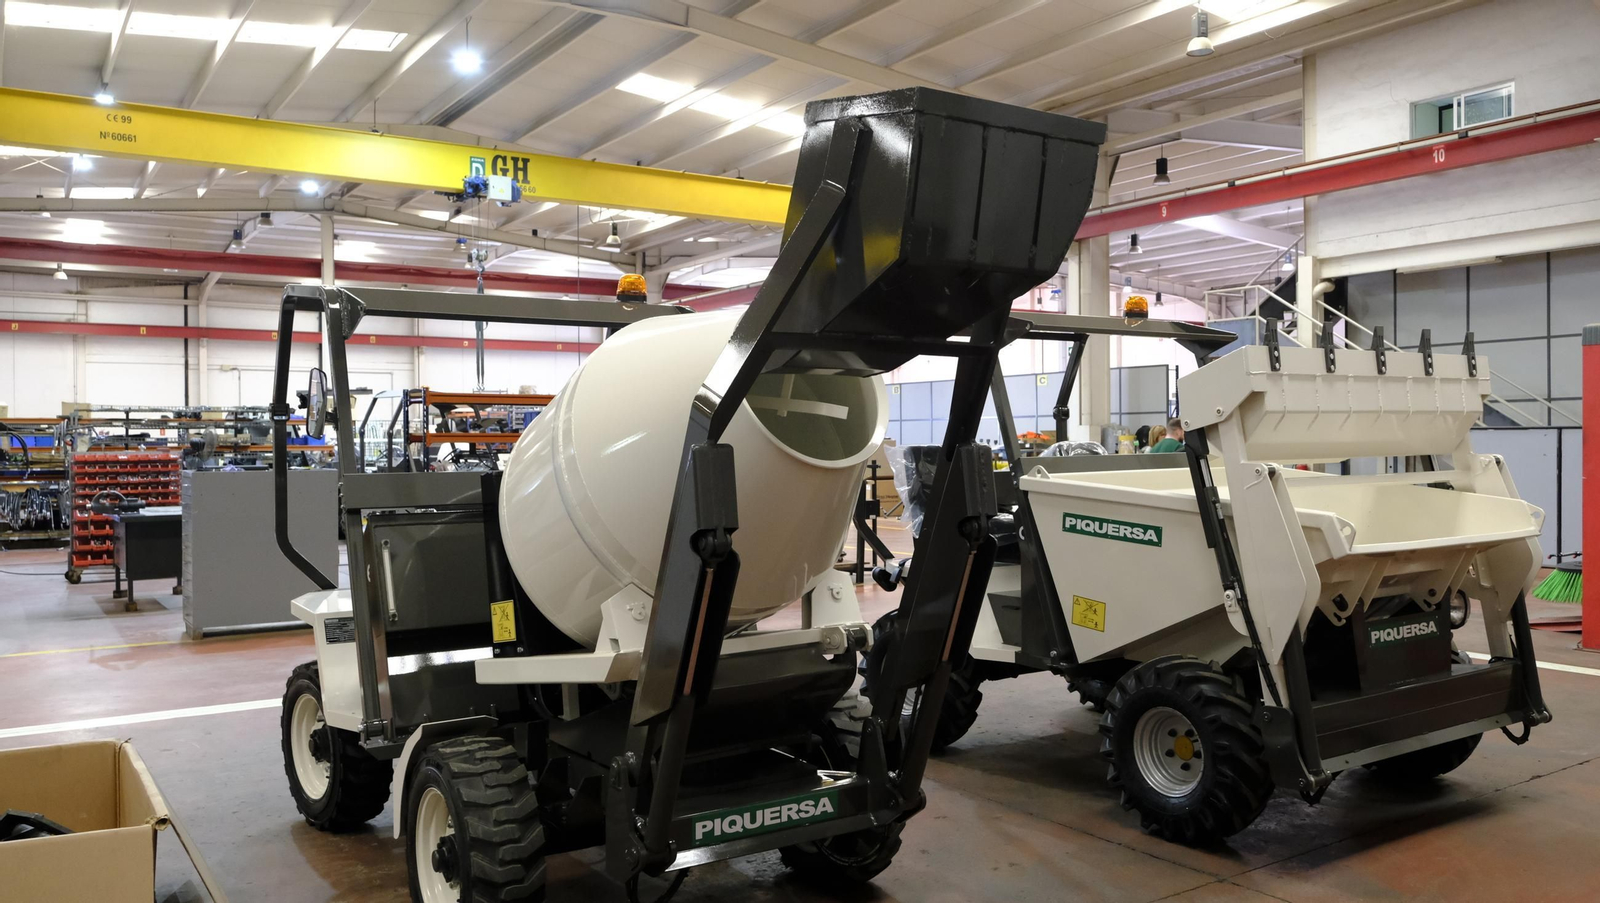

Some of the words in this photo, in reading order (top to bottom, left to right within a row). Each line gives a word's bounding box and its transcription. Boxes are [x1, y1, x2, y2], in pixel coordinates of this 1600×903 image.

[121, 115, 132, 124] 99
[1432, 149, 1445, 163] 10
[491, 154, 530, 184] GH
[1161, 206, 1167, 217] 9
[1039, 376, 1046, 385] C
[1065, 516, 1158, 542] PIQUERSA
[1370, 620, 1437, 644] PIQUERSA
[695, 796, 834, 840] PIQUERSA
